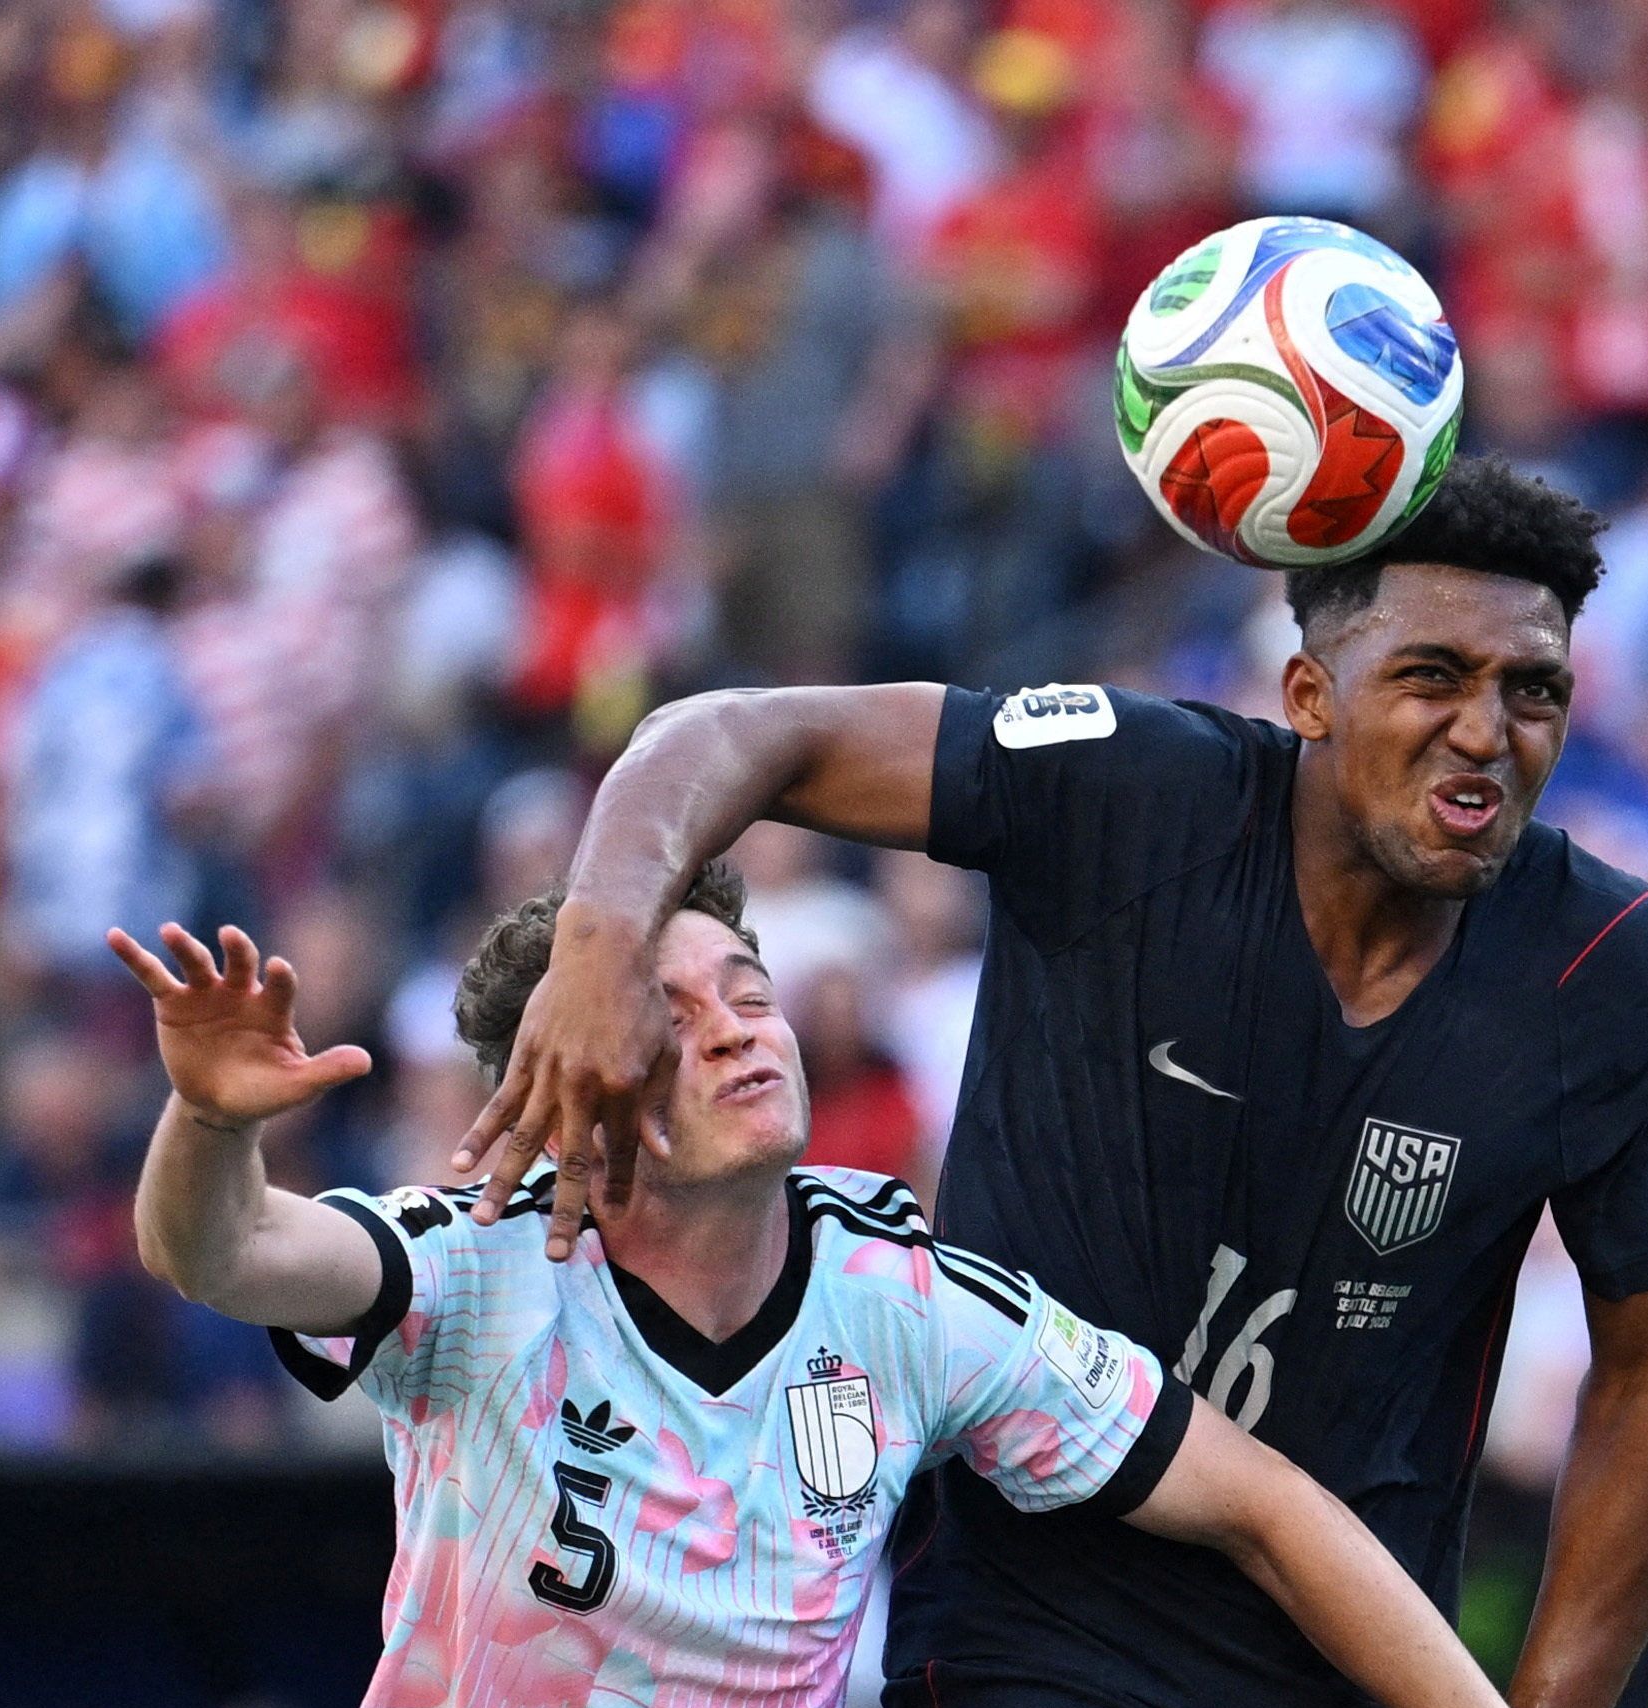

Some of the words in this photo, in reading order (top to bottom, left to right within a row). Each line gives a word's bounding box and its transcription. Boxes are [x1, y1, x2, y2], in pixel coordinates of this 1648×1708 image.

[1366, 1128, 1451, 1184] USA
[1333, 1280, 1352, 1295] USA
[1336, 1316, 1345, 1329] 6
[1344, 1315, 1369, 1328] JULY
[1172, 1243, 1298, 1433] 16
[1106, 1359, 1118, 1380] FIFA
[832, 1384, 856, 1393] ROYAL
[833, 1391, 866, 1401] BELGIAN
[528, 1460, 620, 1616] 5
